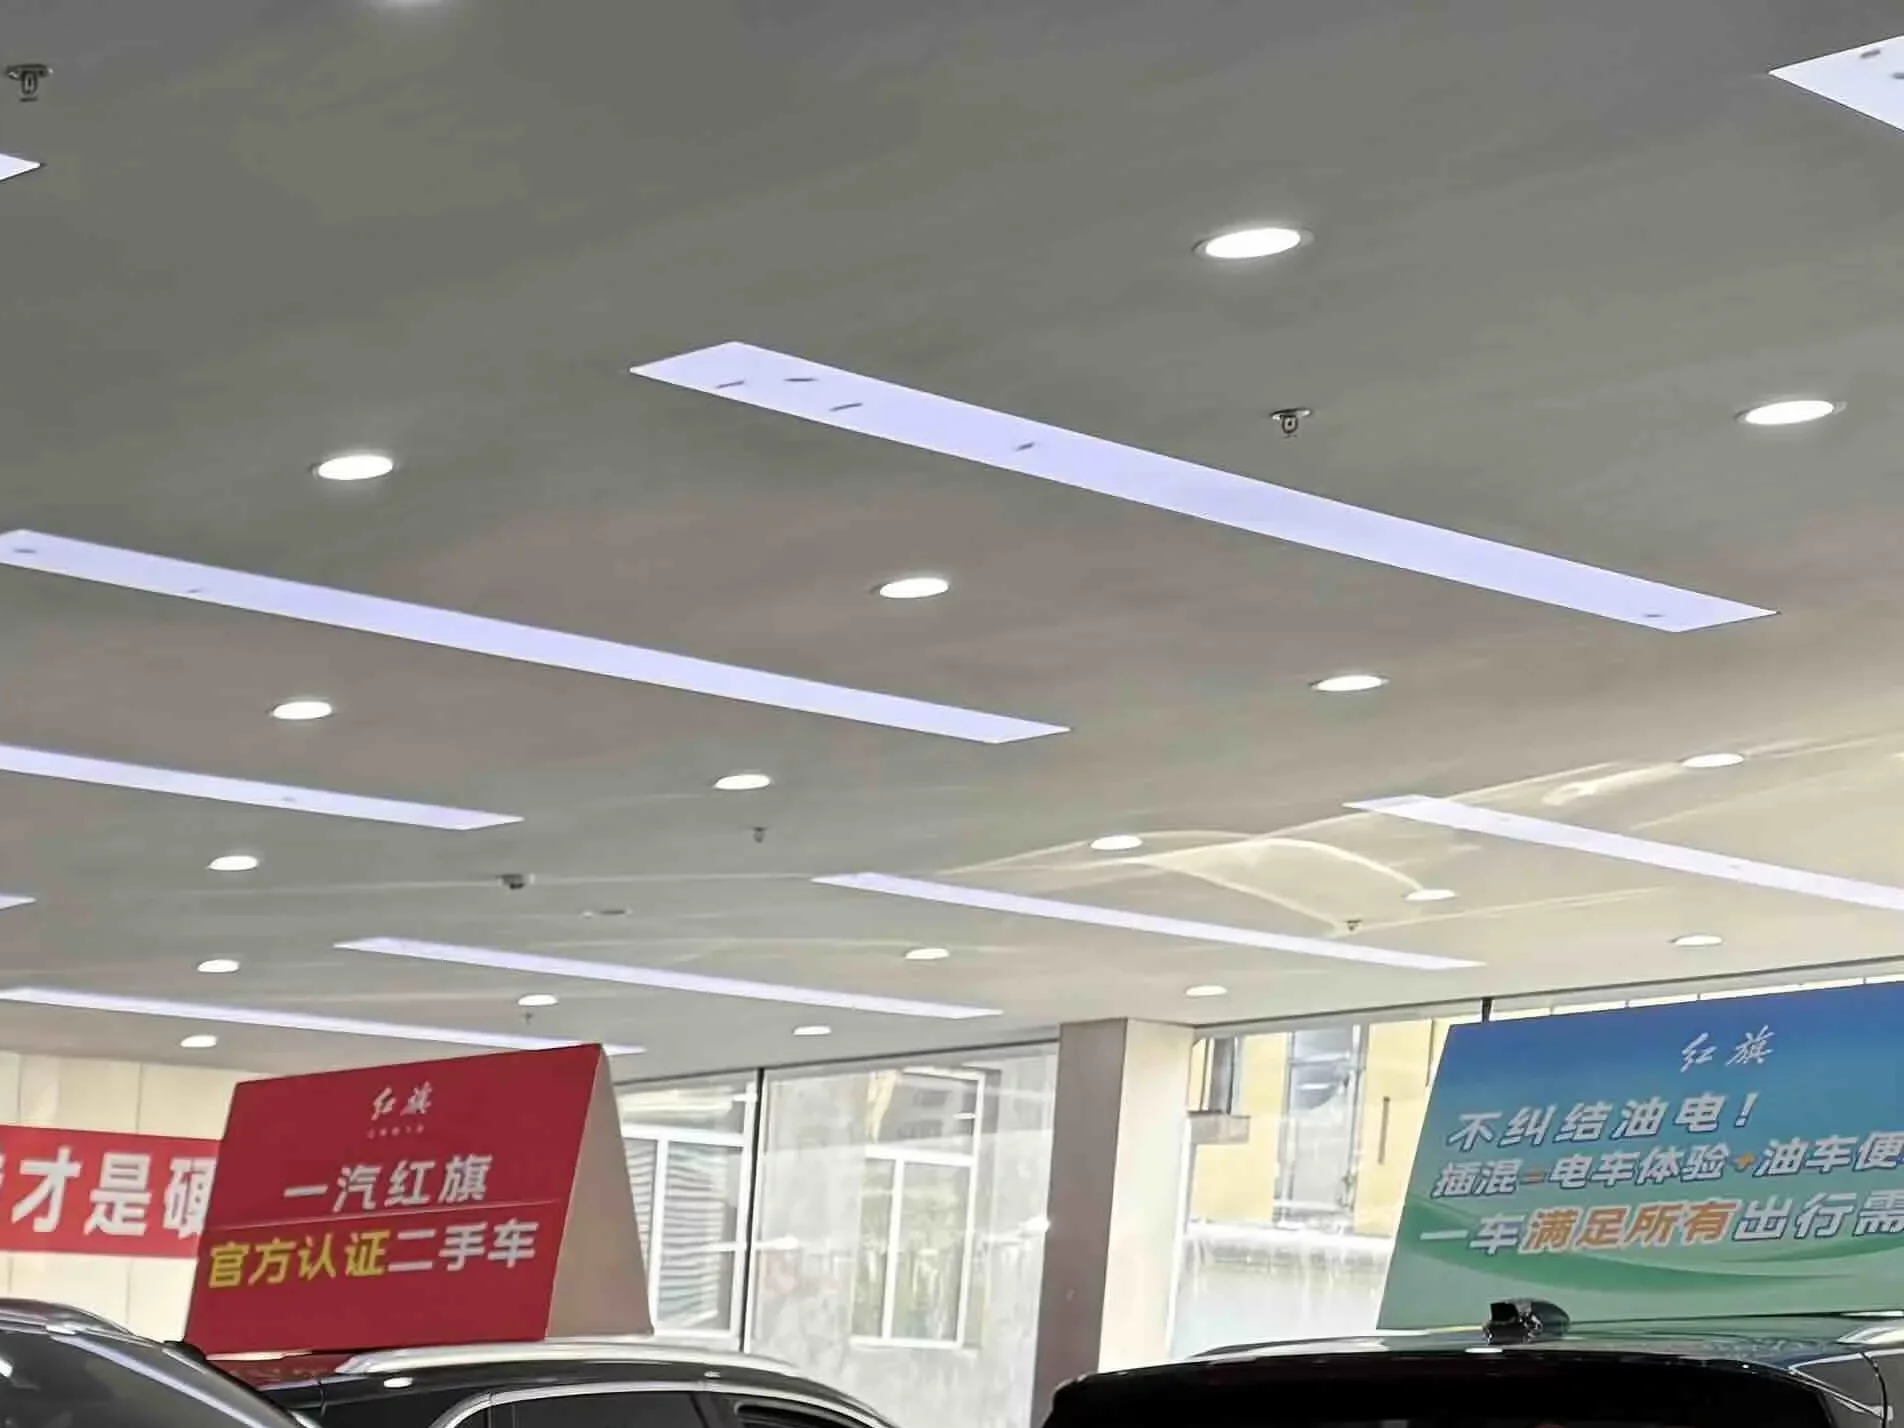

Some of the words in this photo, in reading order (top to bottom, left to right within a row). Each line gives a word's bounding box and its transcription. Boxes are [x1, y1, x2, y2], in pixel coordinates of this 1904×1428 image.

[1680, 1025, 1775, 1073] 红旗
[371, 1081, 432, 1121] 红旗
[283, 1152, 494, 1213] 一汽红旗
[208, 1219, 540, 1290] 官方认证二手车
